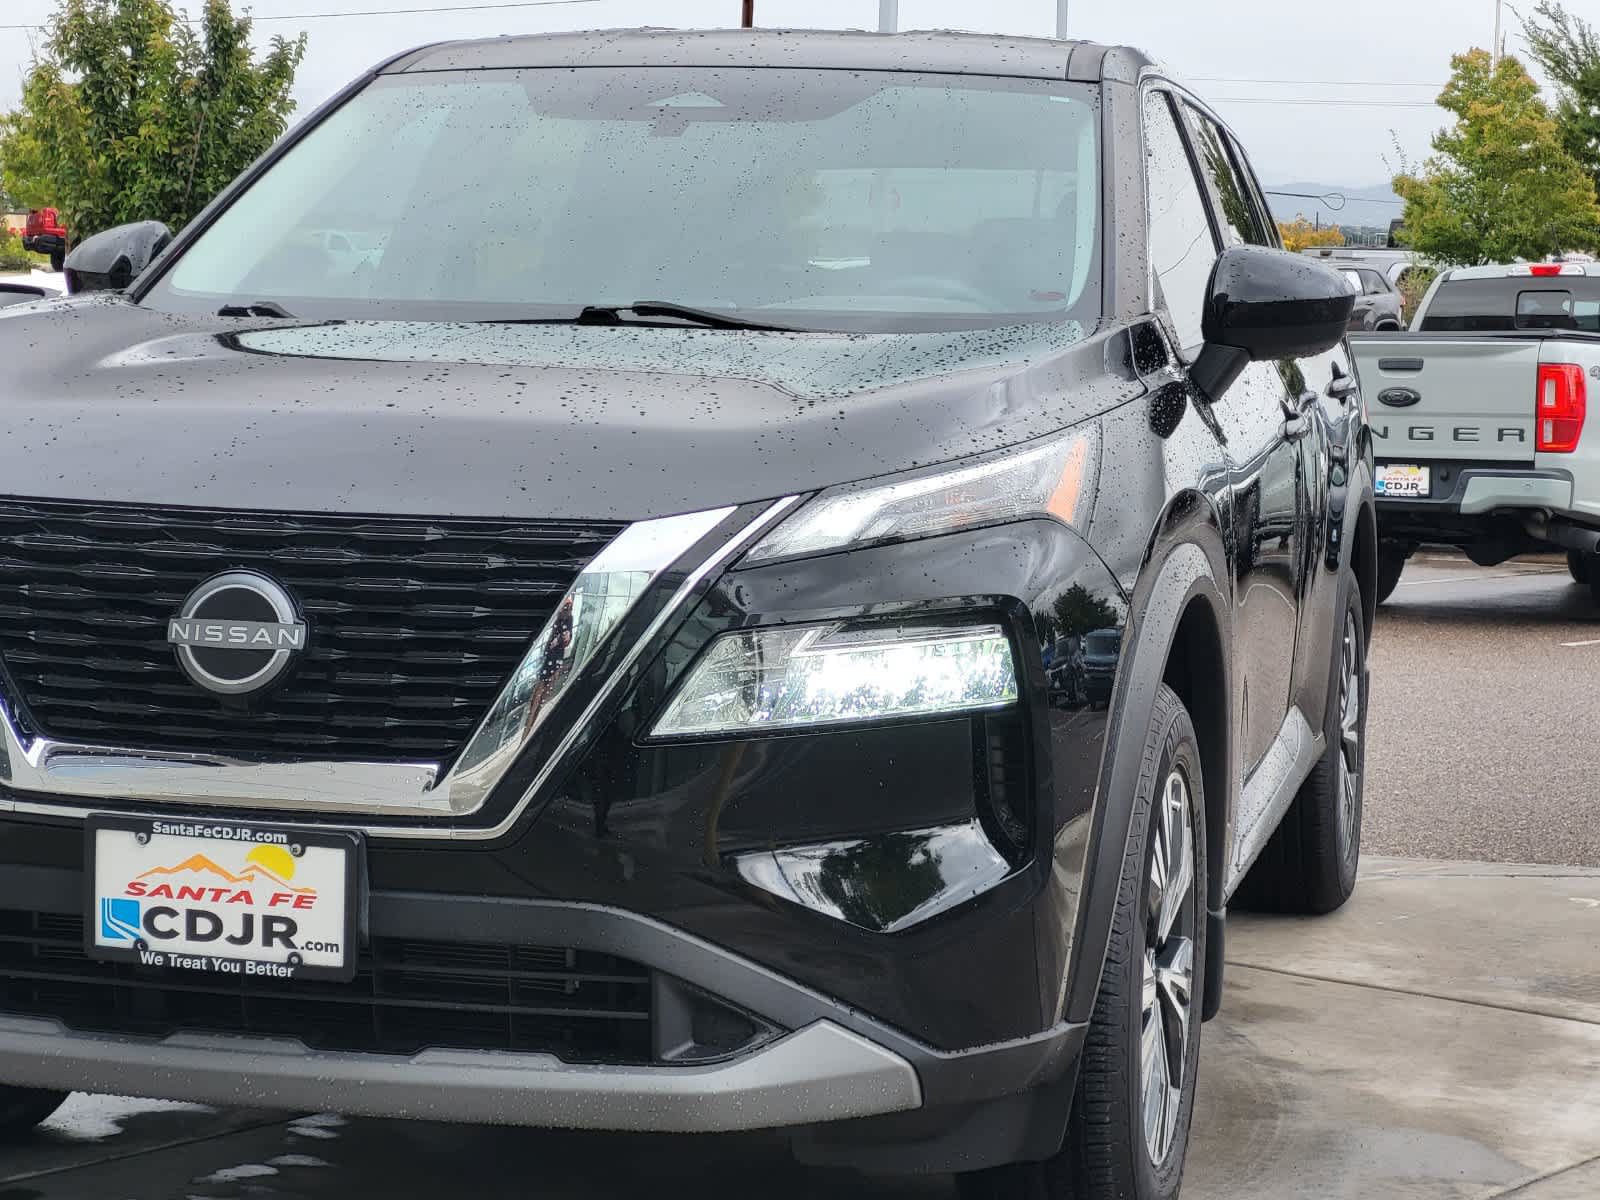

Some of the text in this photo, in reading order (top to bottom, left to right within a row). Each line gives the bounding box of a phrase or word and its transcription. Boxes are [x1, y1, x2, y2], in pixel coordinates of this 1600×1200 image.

[171, 622, 300, 646] NISSAN
[152, 821, 288, 844] SantaFeCDJR.com
[124, 881, 318, 910] SANTA FE
[140, 951, 295, 978] We Treat You Better
